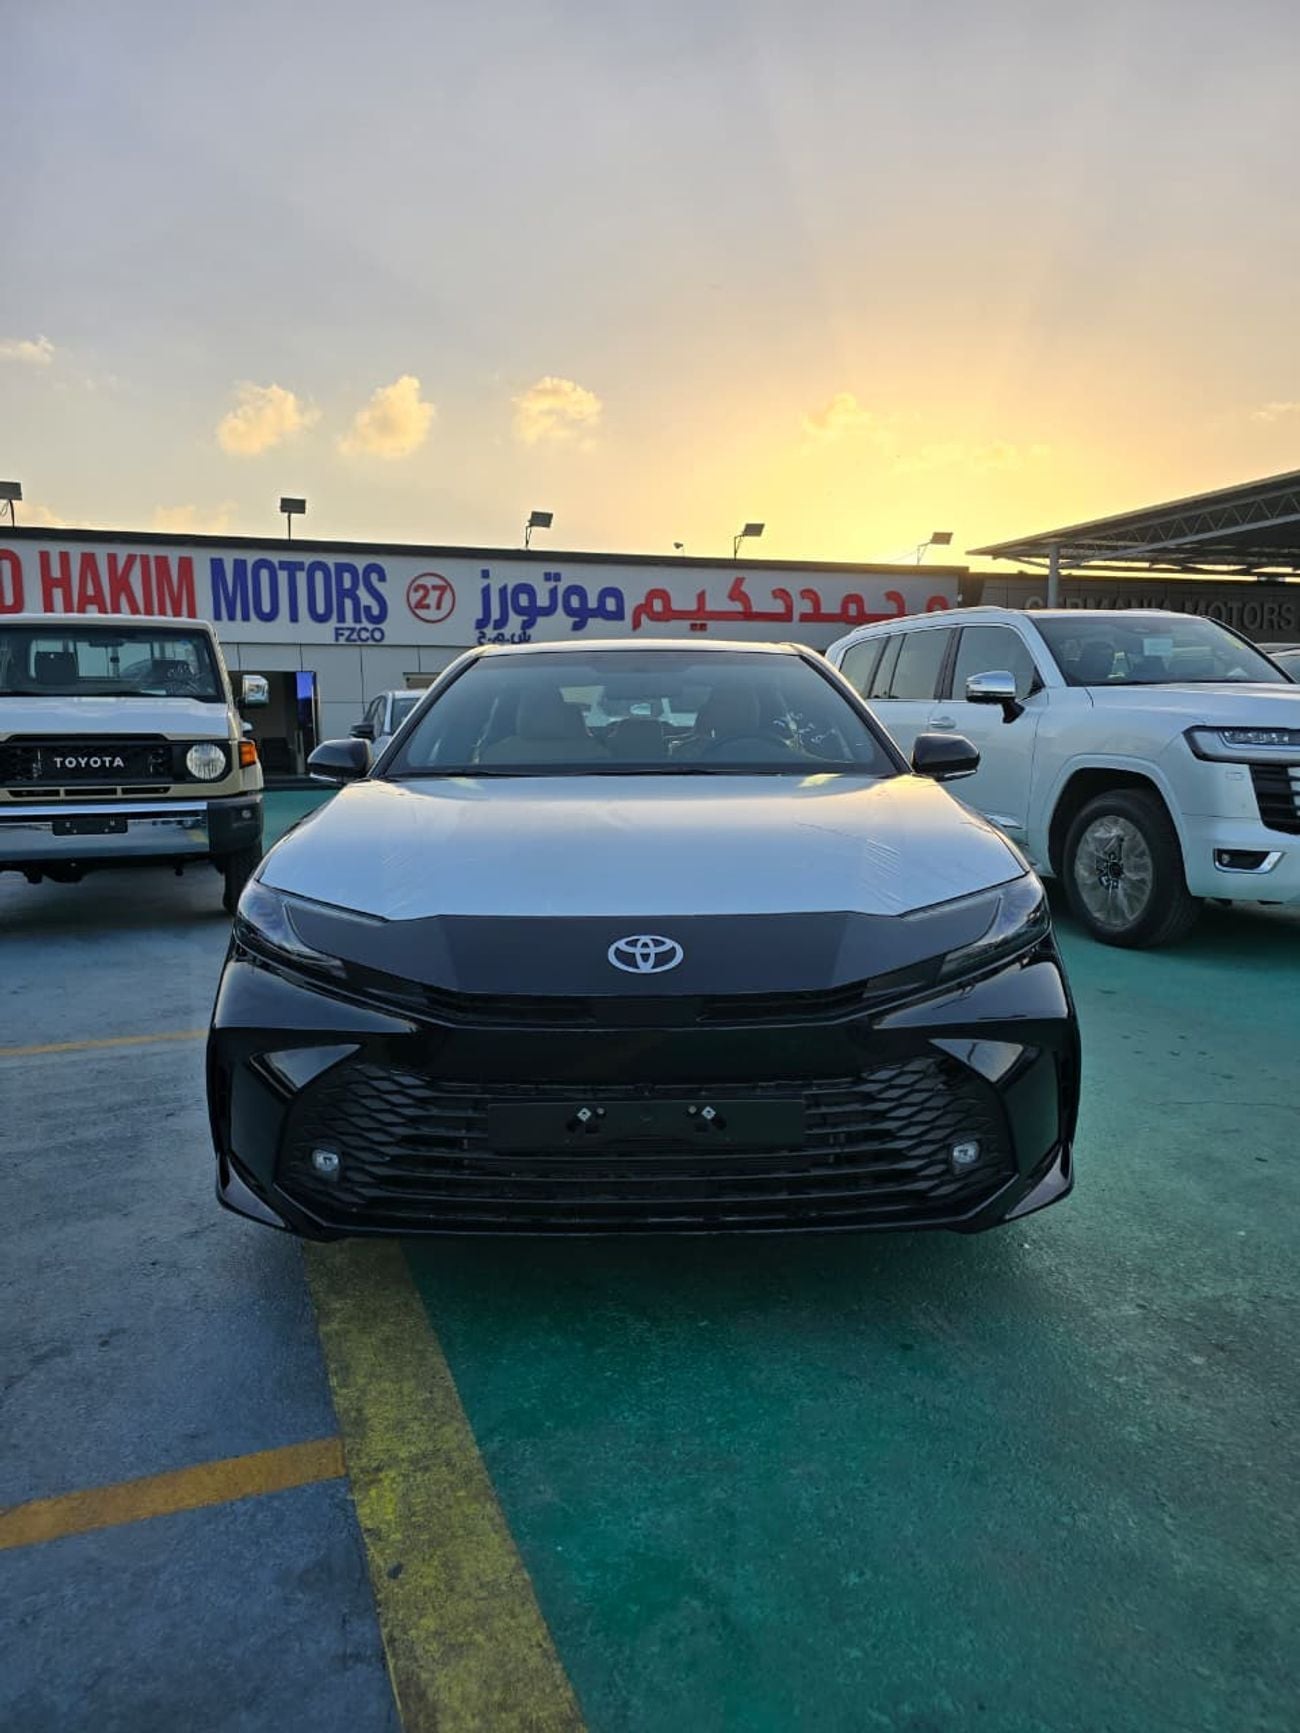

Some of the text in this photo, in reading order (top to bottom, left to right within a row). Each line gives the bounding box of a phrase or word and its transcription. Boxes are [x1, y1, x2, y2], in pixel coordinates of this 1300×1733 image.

[39, 550, 197, 619] HAKIM
[209, 557, 388, 625] MOTORS
[412, 583, 450, 610] 27
[474, 569, 626, 631] موتورز
[631, 577, 794, 631] حكيم
[334, 626, 386, 643] FZCO
[54, 756, 125, 769] TOYOTA
